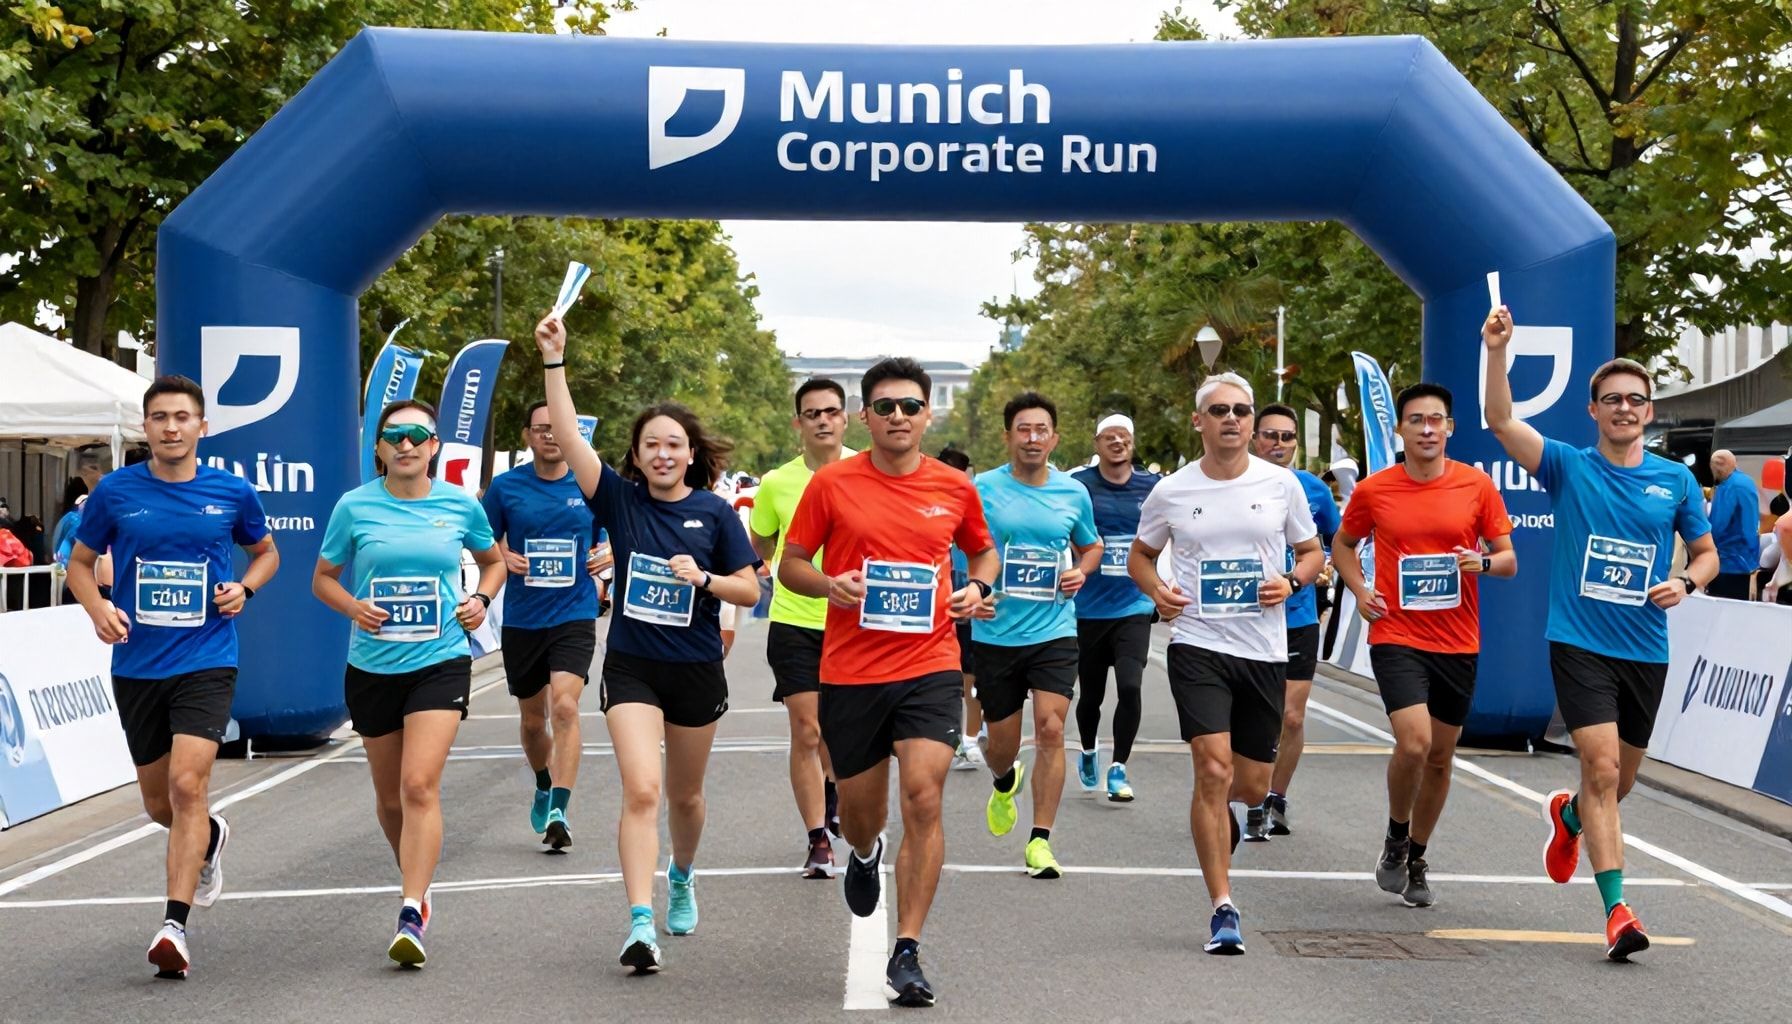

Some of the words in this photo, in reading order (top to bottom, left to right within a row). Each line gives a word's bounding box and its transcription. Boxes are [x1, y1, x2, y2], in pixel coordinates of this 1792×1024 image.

[780, 68, 1051, 125] Munich
[777, 131, 1044, 181] Corporate
[1062, 134, 1157, 173] Run
